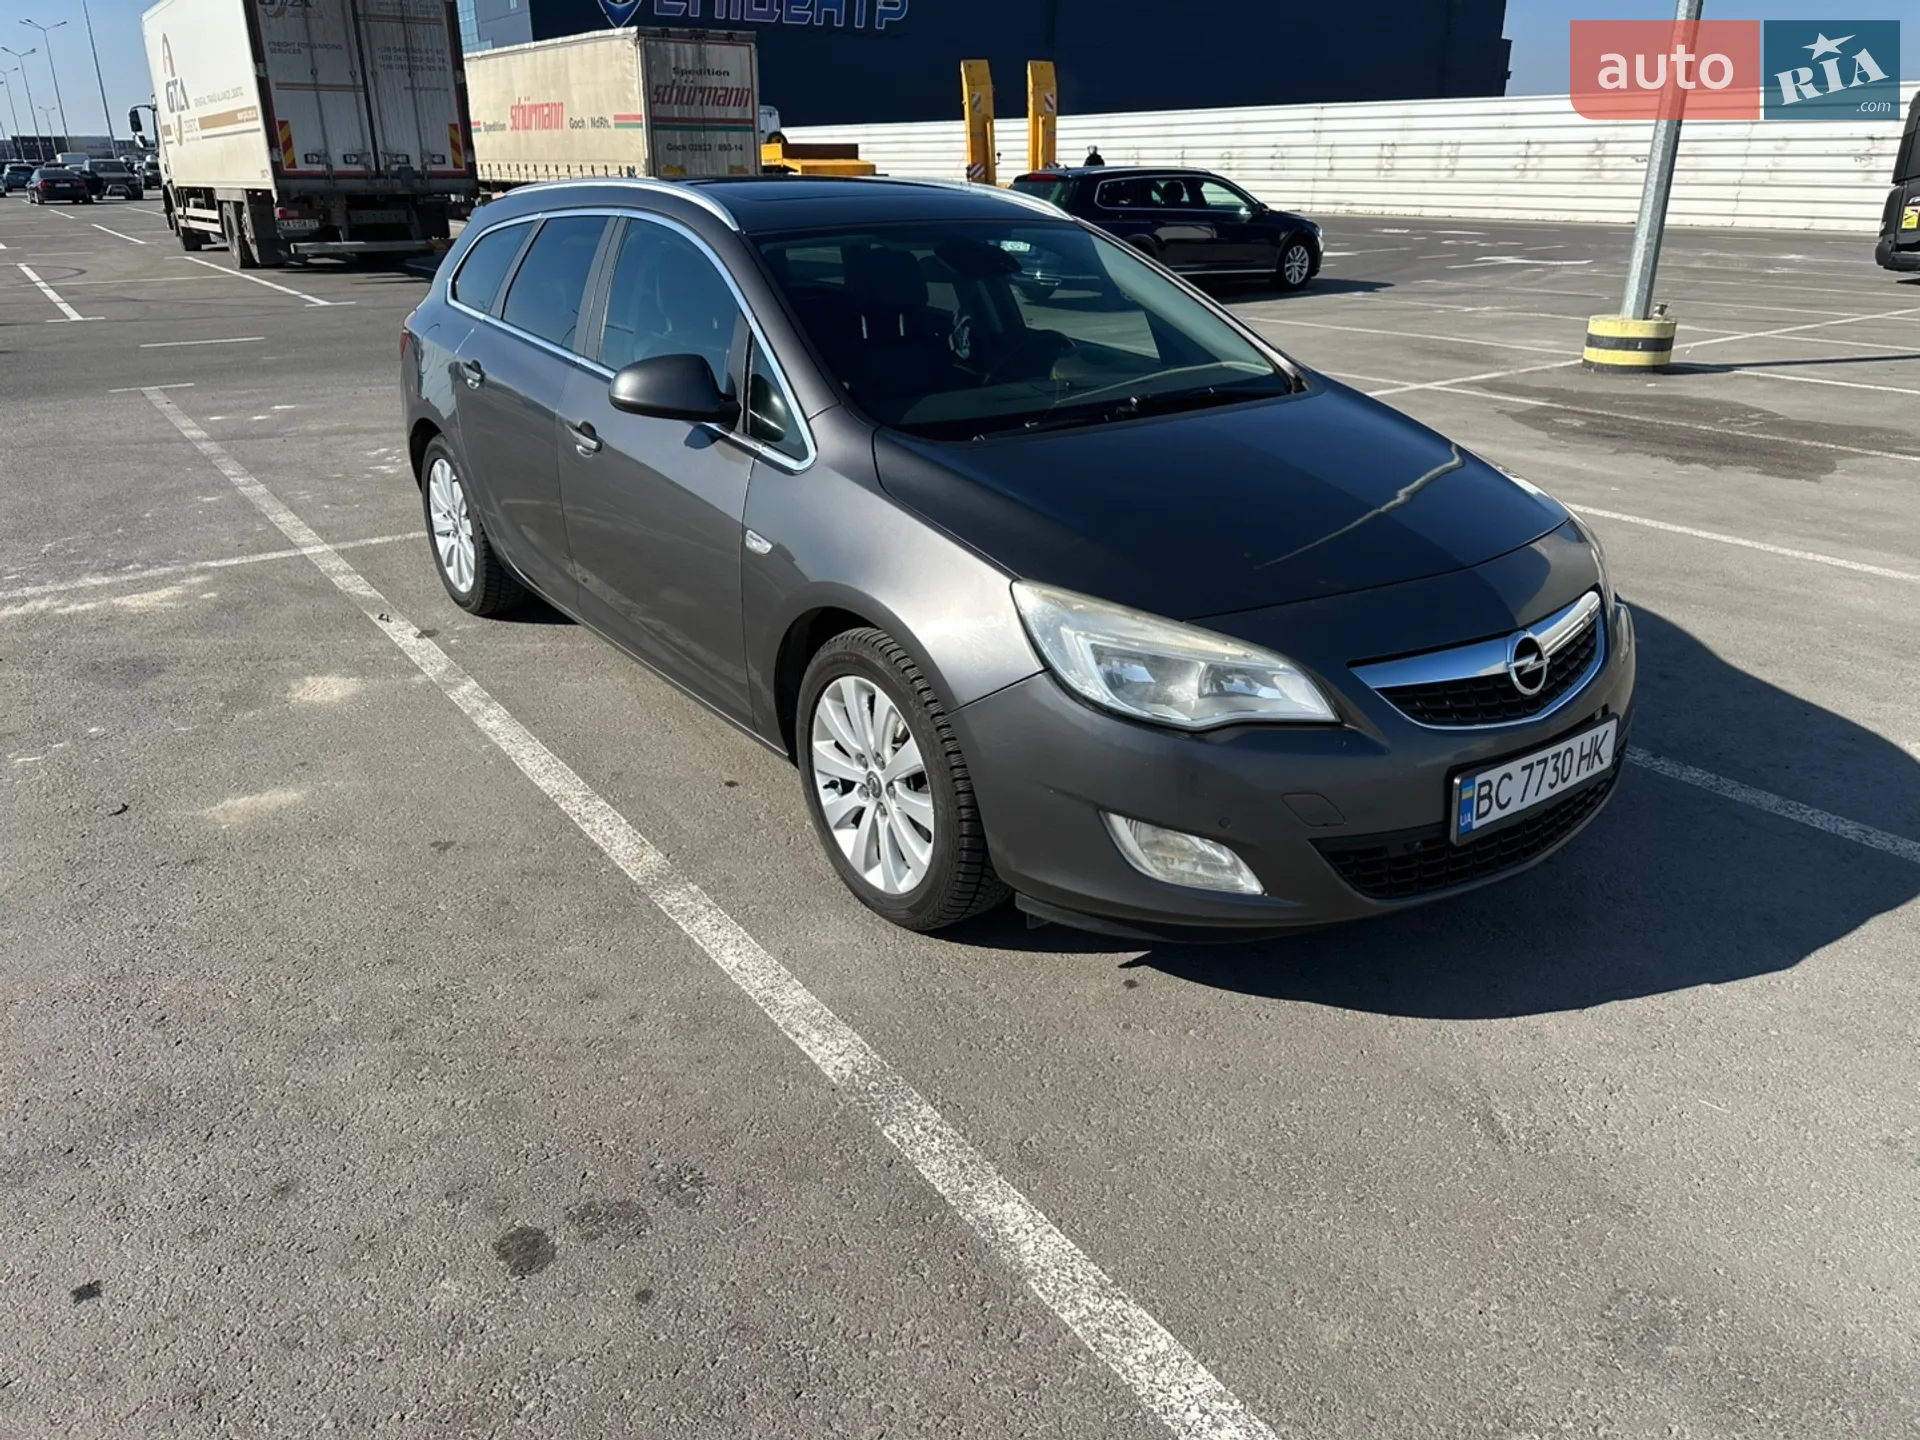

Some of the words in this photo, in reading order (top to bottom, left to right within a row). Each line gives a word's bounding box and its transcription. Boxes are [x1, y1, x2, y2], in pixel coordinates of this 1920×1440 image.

[672, 67, 730, 77] Spedition
[651, 79, 750, 108] schürmann
[483, 121, 507, 134] Spedition
[569, 117, 586, 129] Goch
[666, 143, 688, 152] Goch
[1475, 772, 1512, 821] BC
[1520, 747, 1574, 803] 7730
[1576, 730, 1609, 777] HK
[1460, 812, 1472, 827] UA
